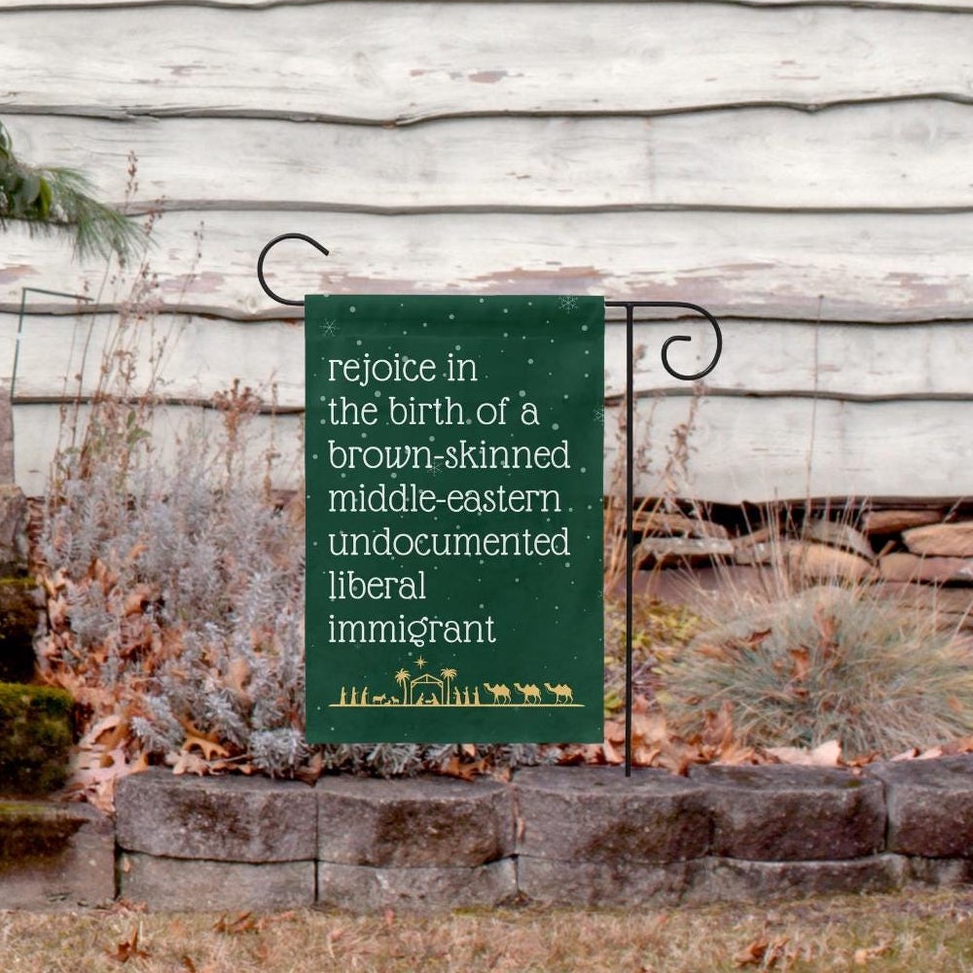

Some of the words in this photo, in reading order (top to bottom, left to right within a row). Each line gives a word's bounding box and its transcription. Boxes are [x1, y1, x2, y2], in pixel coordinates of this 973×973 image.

[328, 353, 436, 387] rejoice
[447, 353, 478, 382] in
[328, 397, 378, 425] the
[388, 397, 465, 425] birth
[476, 397, 510, 425] of
[520, 402, 540, 425] a
[328, 440, 571, 469] brown-skinned
[328, 483, 562, 512] middle-eastern
[328, 527, 571, 556] undocumented
[328, 570, 427, 600] liberal
[328, 614, 497, 648] immigrant
